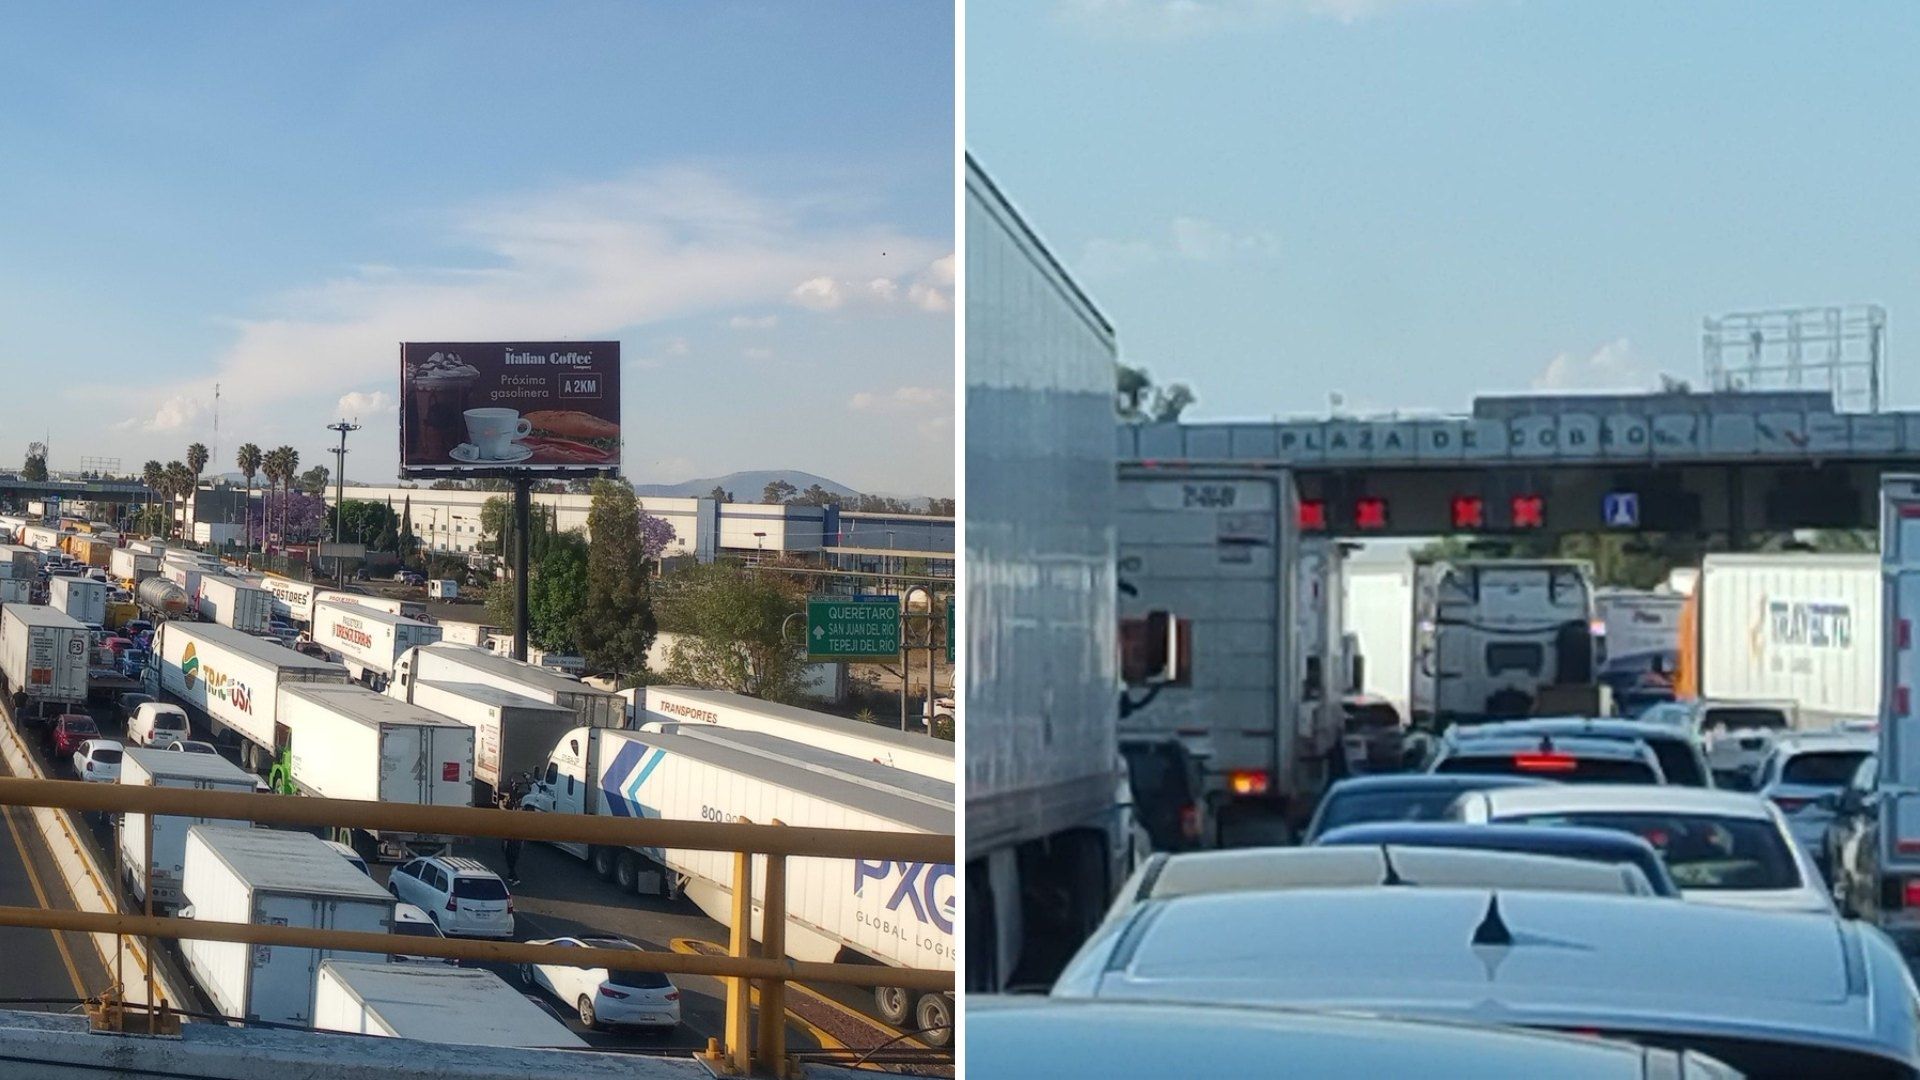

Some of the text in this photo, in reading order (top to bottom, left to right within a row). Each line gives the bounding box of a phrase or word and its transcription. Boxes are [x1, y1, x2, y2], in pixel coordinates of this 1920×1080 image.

[505, 352, 592, 365] Italian Coffee
[501, 375, 546, 385] Próxima
[564, 380, 596, 393] A 2KM
[491, 386, 549, 400] gasolinera
[1281, 430, 1401, 450] PLAZA
[1433, 430, 1477, 448] DE
[828, 604, 895, 620] QUERÉTARO
[828, 623, 844, 636] SAN
[845, 623, 865, 636] JUAN
[866, 623, 881, 636] DEL
[829, 639, 858, 652] TEPEJI
[860, 639, 878, 652] DEL
[660, 700, 718, 724] TRANSPORTES
[701, 804, 722, 823] 800
[855, 910, 908, 942] GLOBAL
